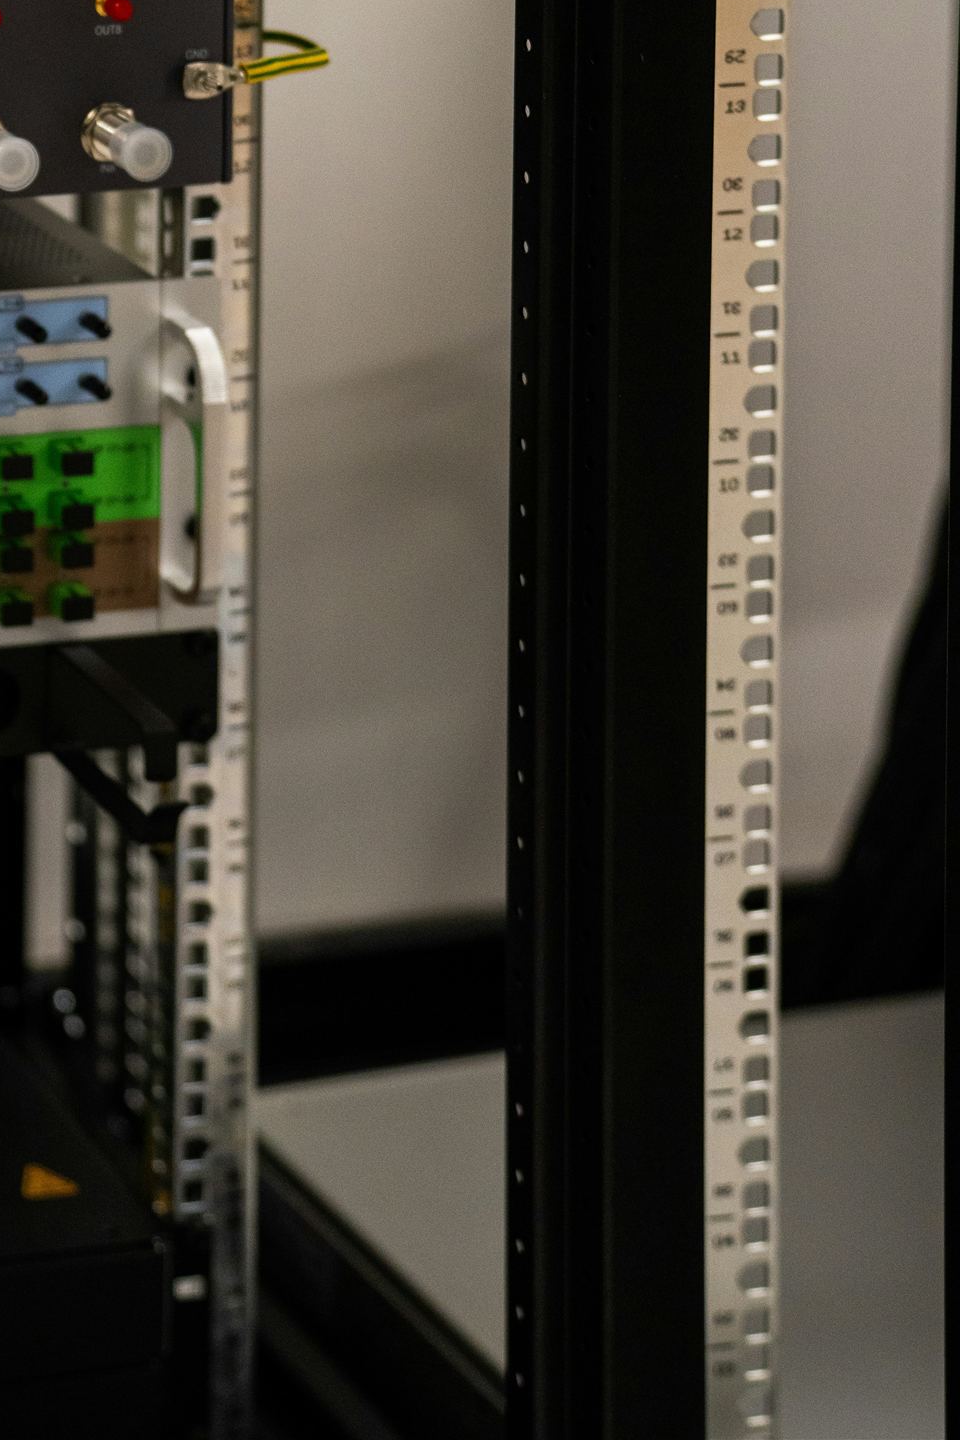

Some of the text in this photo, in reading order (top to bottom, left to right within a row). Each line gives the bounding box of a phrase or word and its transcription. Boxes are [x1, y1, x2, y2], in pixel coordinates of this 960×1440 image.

[95, 24, 122, 36] OUT8
[725, 99, 746, 114] 13
[724, 228, 743, 241] 12
